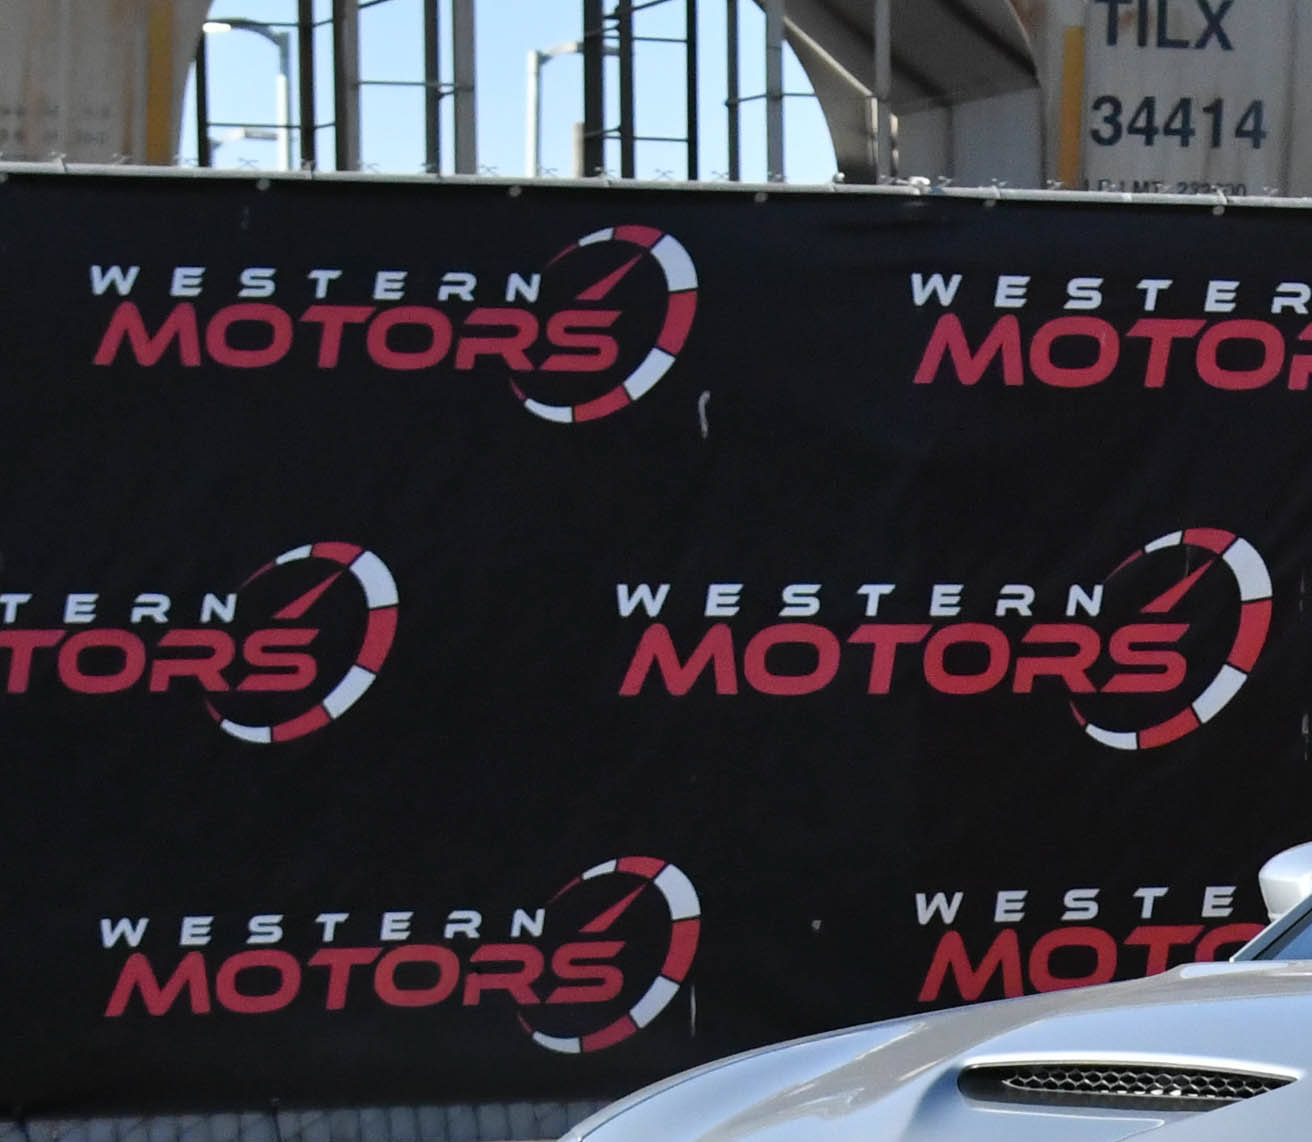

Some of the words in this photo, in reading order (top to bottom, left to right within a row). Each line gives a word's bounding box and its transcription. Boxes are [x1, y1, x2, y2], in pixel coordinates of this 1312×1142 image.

[1095, 0, 1235, 50] TILX
[1090, 95, 1267, 149] 34414
[90, 266, 541, 303] WESTERN
[94, 302, 622, 371] MOTORS
[0, 593, 238, 623] TERN
[616, 583, 1103, 617] WESTERN
[0, 628, 319, 694] TORS
[619, 621, 1190, 696] MOTORS
[100, 909, 546, 948] WESTERN
[915, 886, 1236, 925] WESTE
[104, 939, 626, 1018] MOTORS
